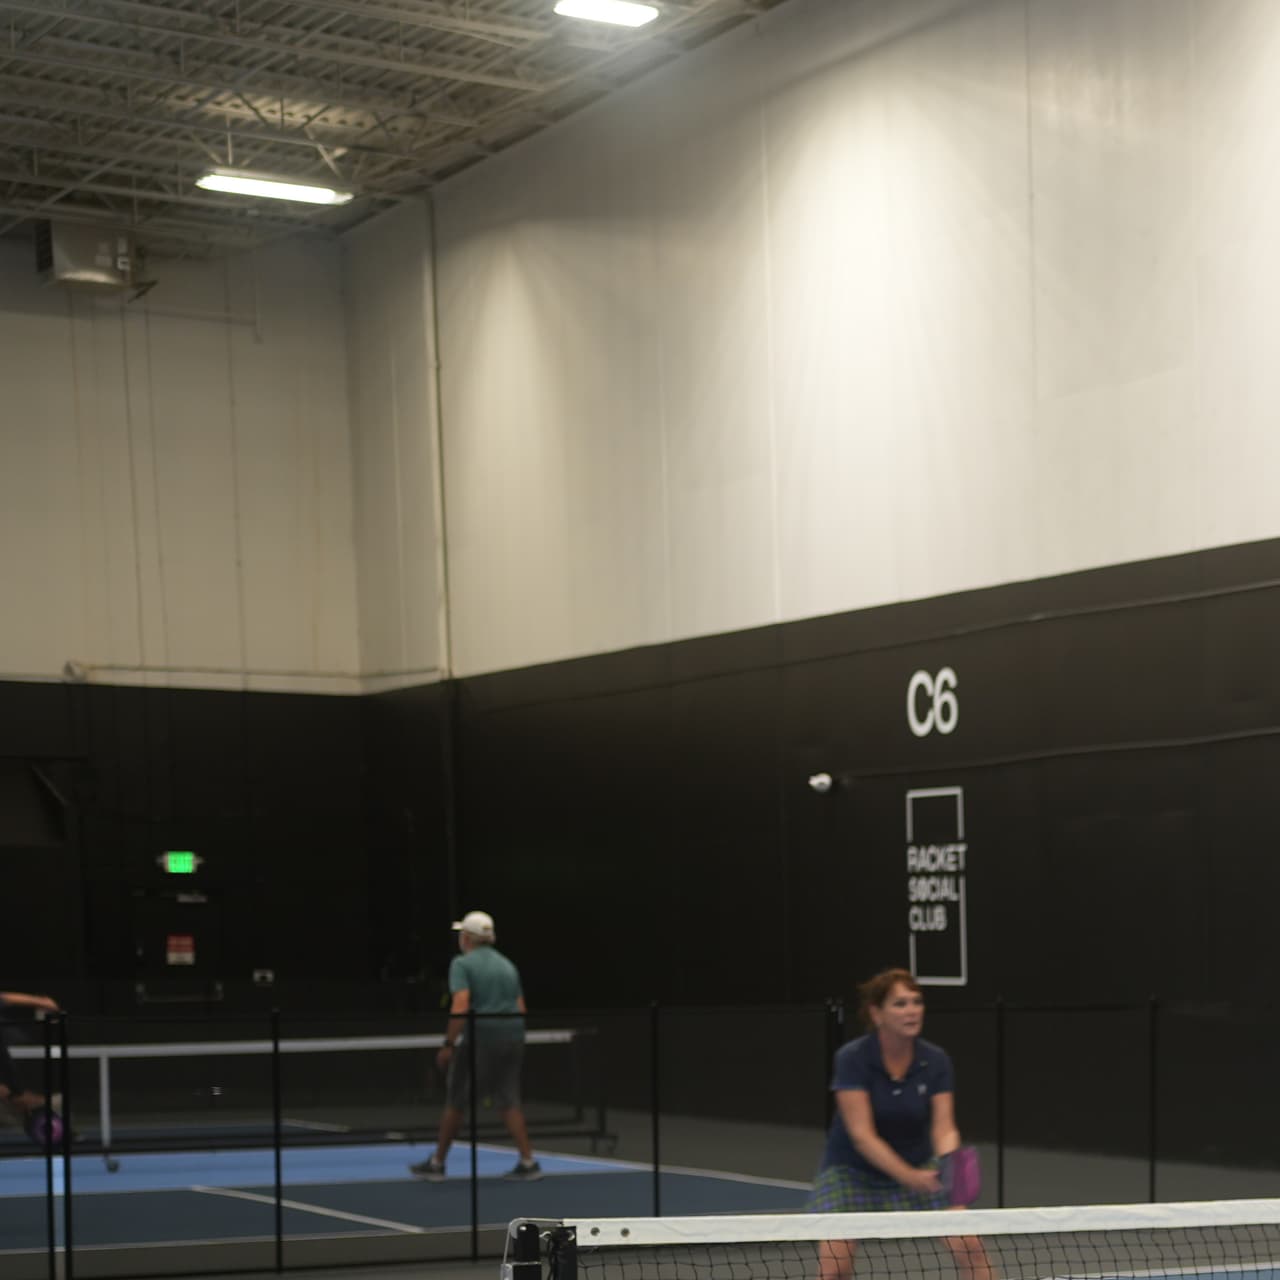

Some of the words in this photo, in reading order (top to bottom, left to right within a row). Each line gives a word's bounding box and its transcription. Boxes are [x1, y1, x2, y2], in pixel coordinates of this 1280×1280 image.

[907, 667, 958, 737] C6
[907, 844, 967, 872] RACKET
[908, 904, 947, 931] CLUB
